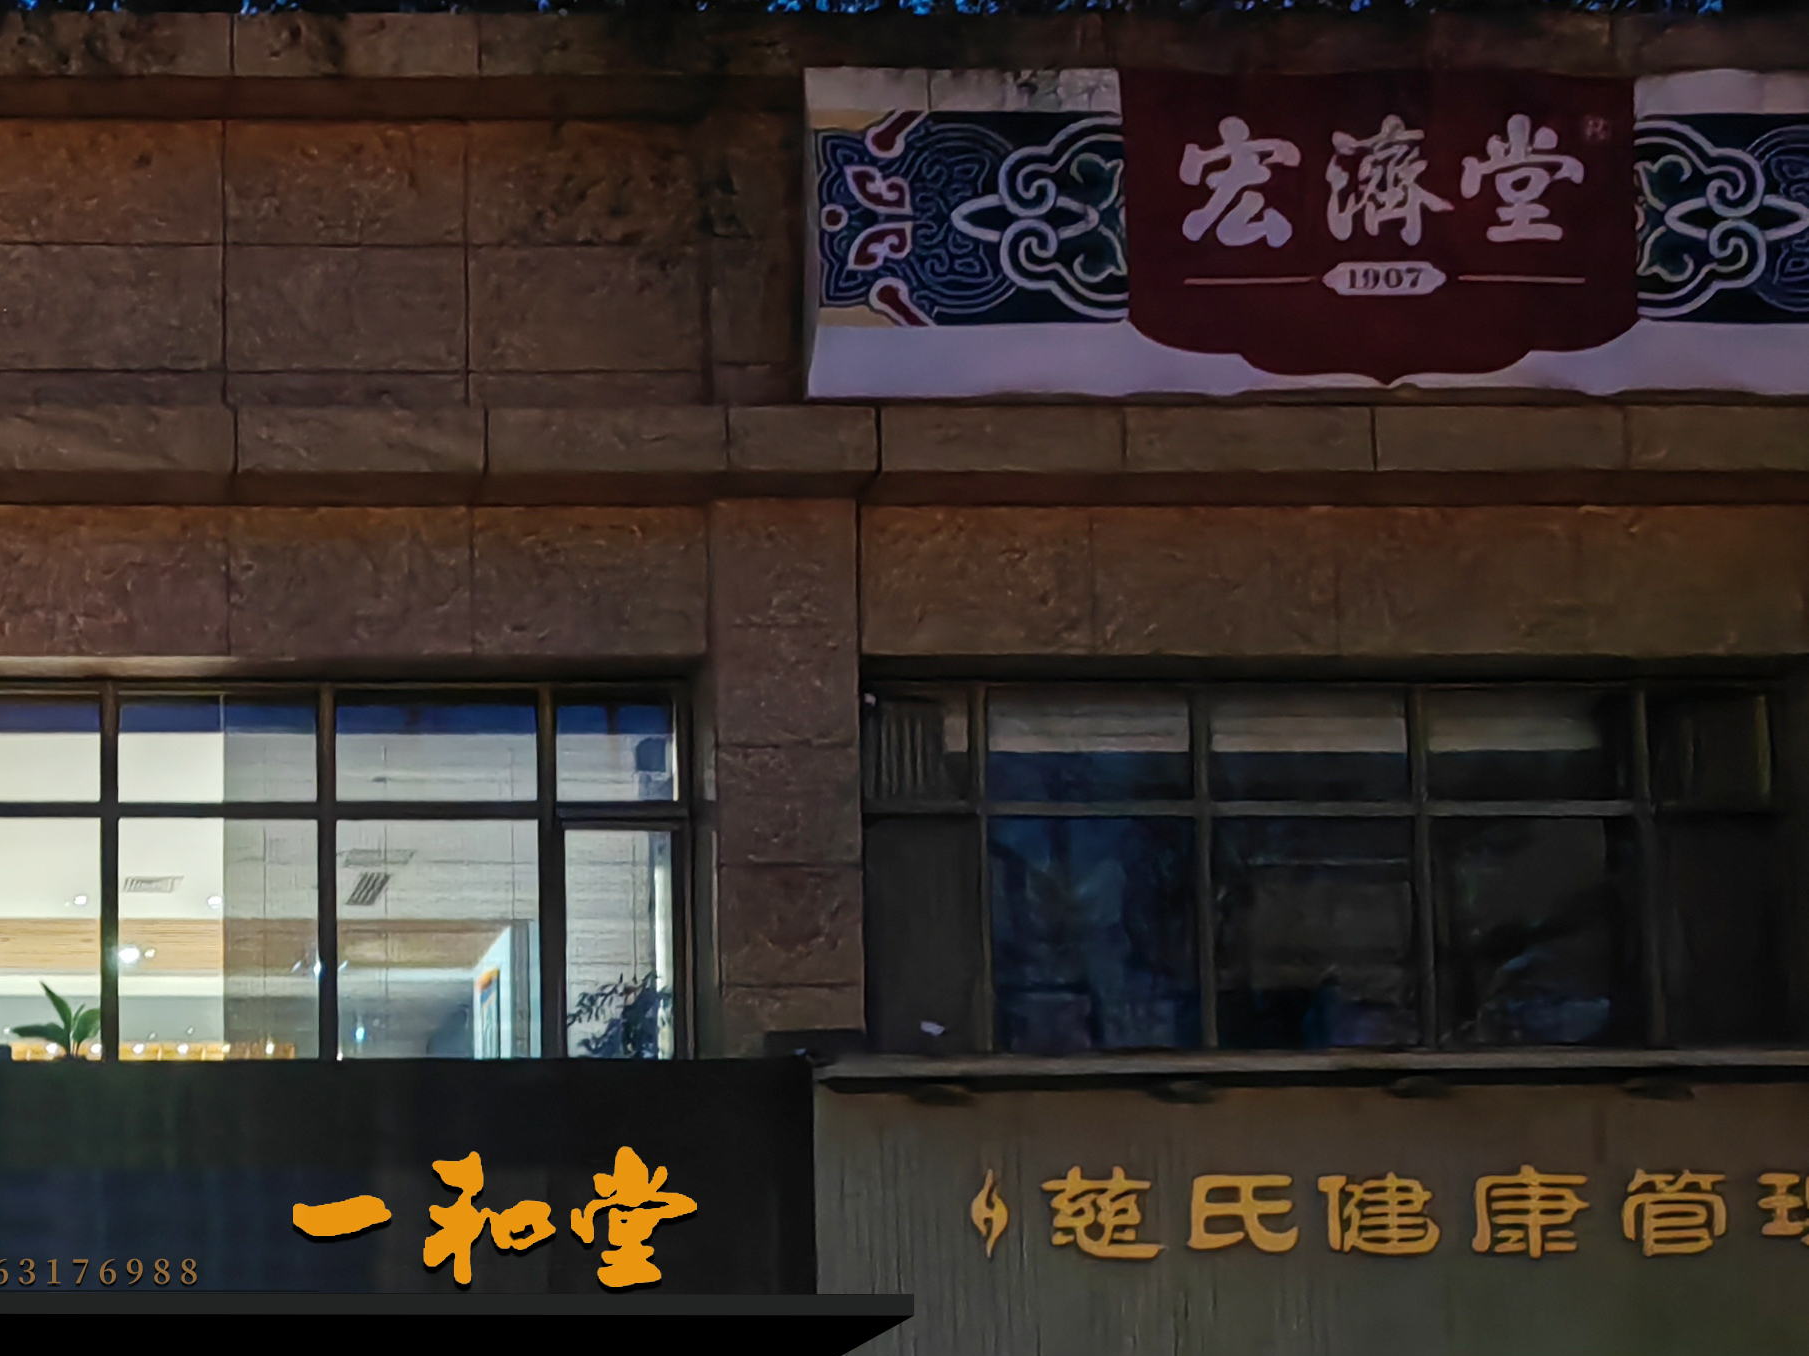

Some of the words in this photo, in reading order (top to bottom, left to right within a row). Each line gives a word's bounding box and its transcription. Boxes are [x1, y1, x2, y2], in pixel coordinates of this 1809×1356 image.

[1348, 267, 1423, 290] 1907
[292, 1146, 698, 1288] 一和堂
